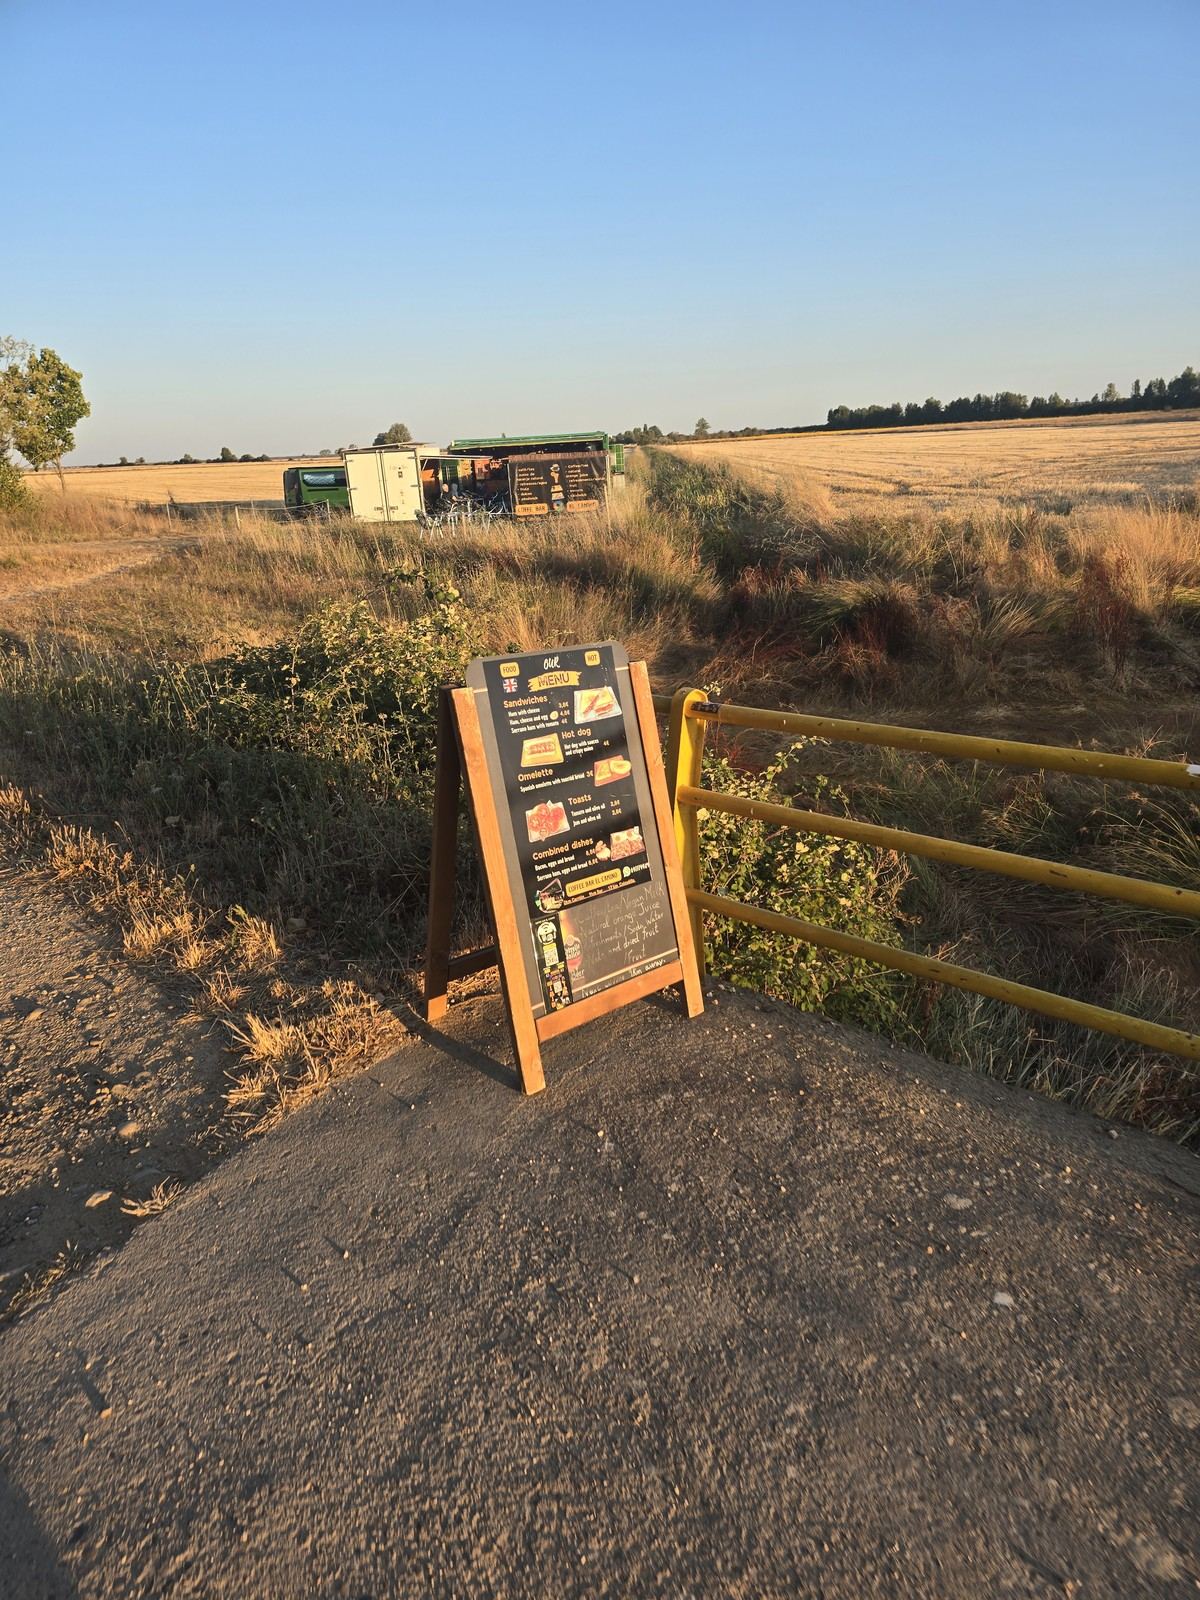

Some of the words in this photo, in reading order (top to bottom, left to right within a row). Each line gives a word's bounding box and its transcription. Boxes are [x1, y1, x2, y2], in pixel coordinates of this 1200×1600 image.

[502, 665, 517, 674] FOOD
[538, 673, 570, 688] MENU
[503, 695, 548, 709] Sandwiches
[518, 708, 528, 716] with
[536, 722, 546, 730] with
[561, 730, 576, 740] Hot
[577, 728, 592, 737] dog
[518, 768, 554, 782] Omelette
[520, 782, 536, 793] Spanish
[568, 794, 592, 806] Toasts
[532, 843, 570, 861] Combined
[571, 837, 594, 850] dishes
[568, 882, 586, 893] COFFEE
[585, 880, 596, 890] BAR
[595, 877, 601, 886] EL
[600, 872, 618, 885] CAMINO
[638, 901, 661, 917] Juice
